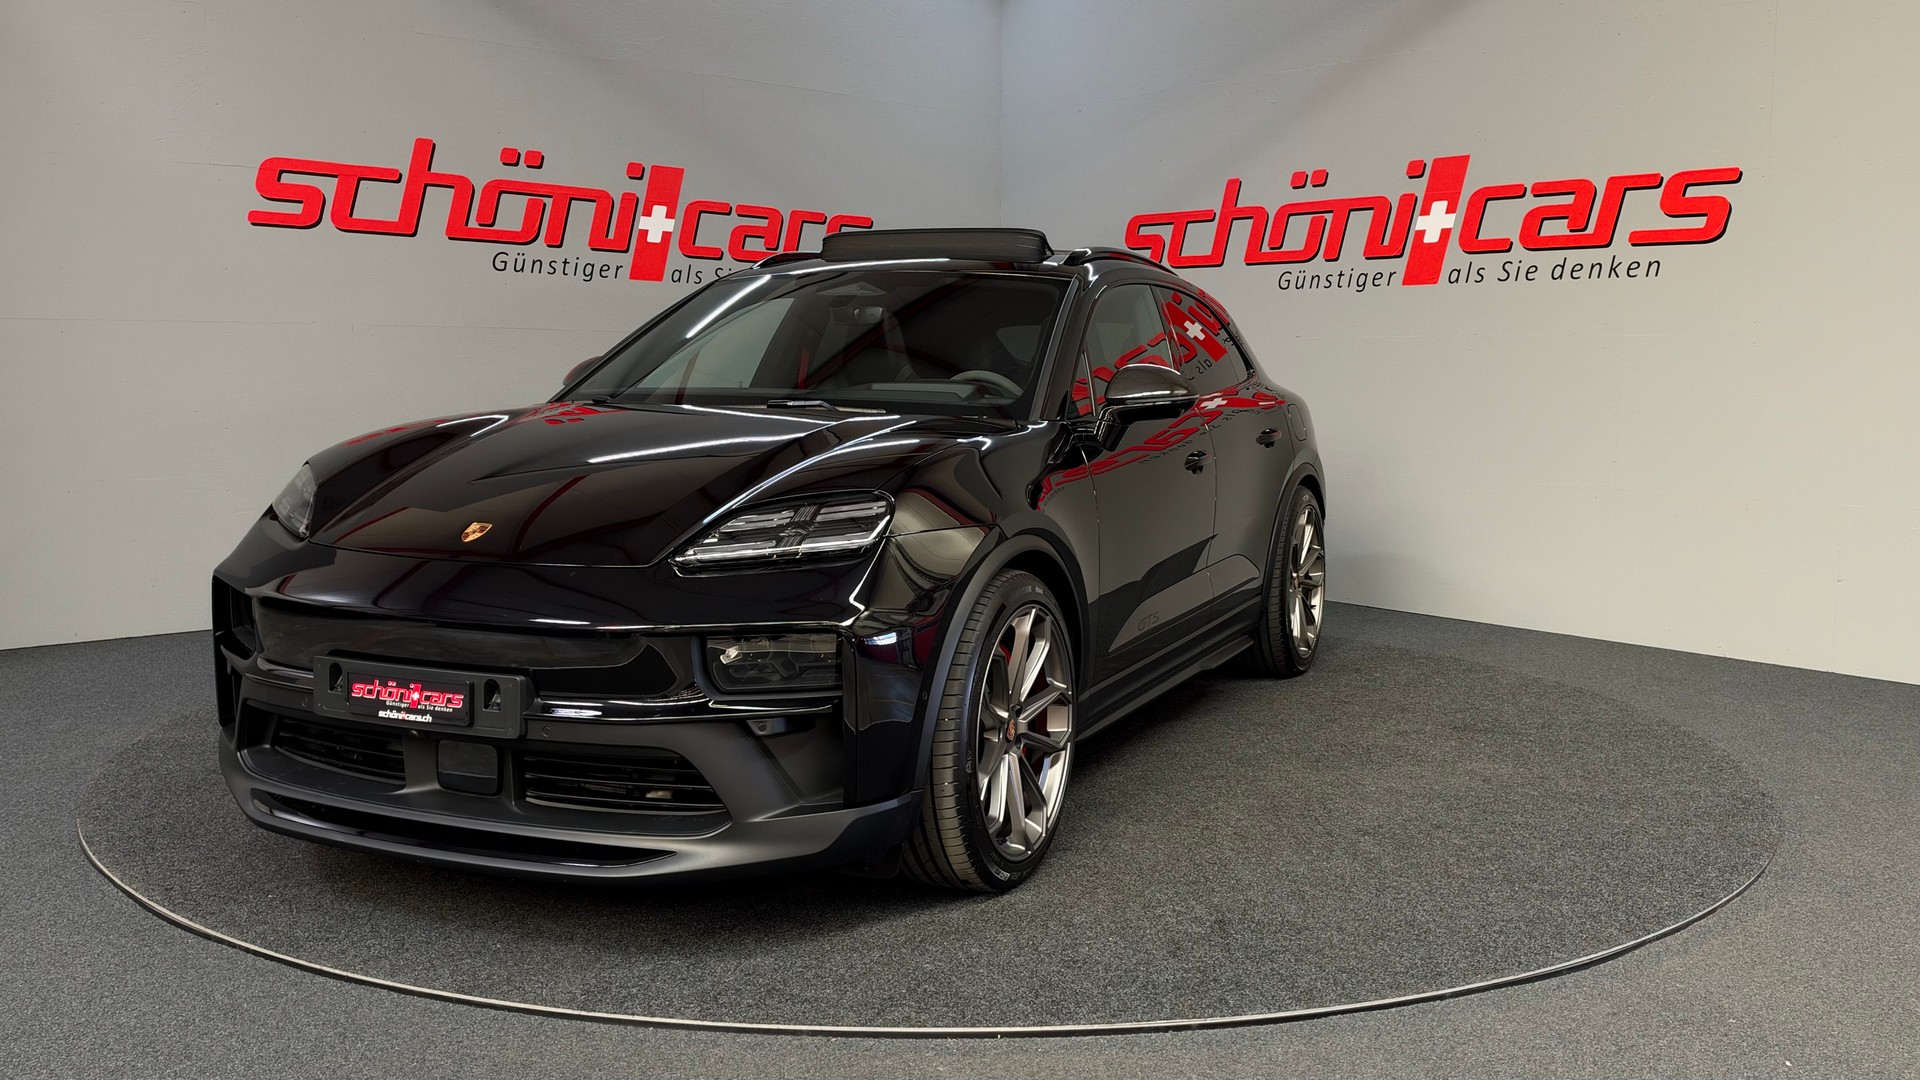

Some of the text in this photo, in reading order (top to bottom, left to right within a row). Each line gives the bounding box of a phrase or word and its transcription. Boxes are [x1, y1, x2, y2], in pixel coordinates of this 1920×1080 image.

[492, 251, 624, 283] Günstiger
[670, 264, 703, 285] als
[1277, 255, 1662, 293] Günstiger als Sie denken
[1137, 611, 1160, 632] GTS
[385, 700, 410, 709] Günstiger
